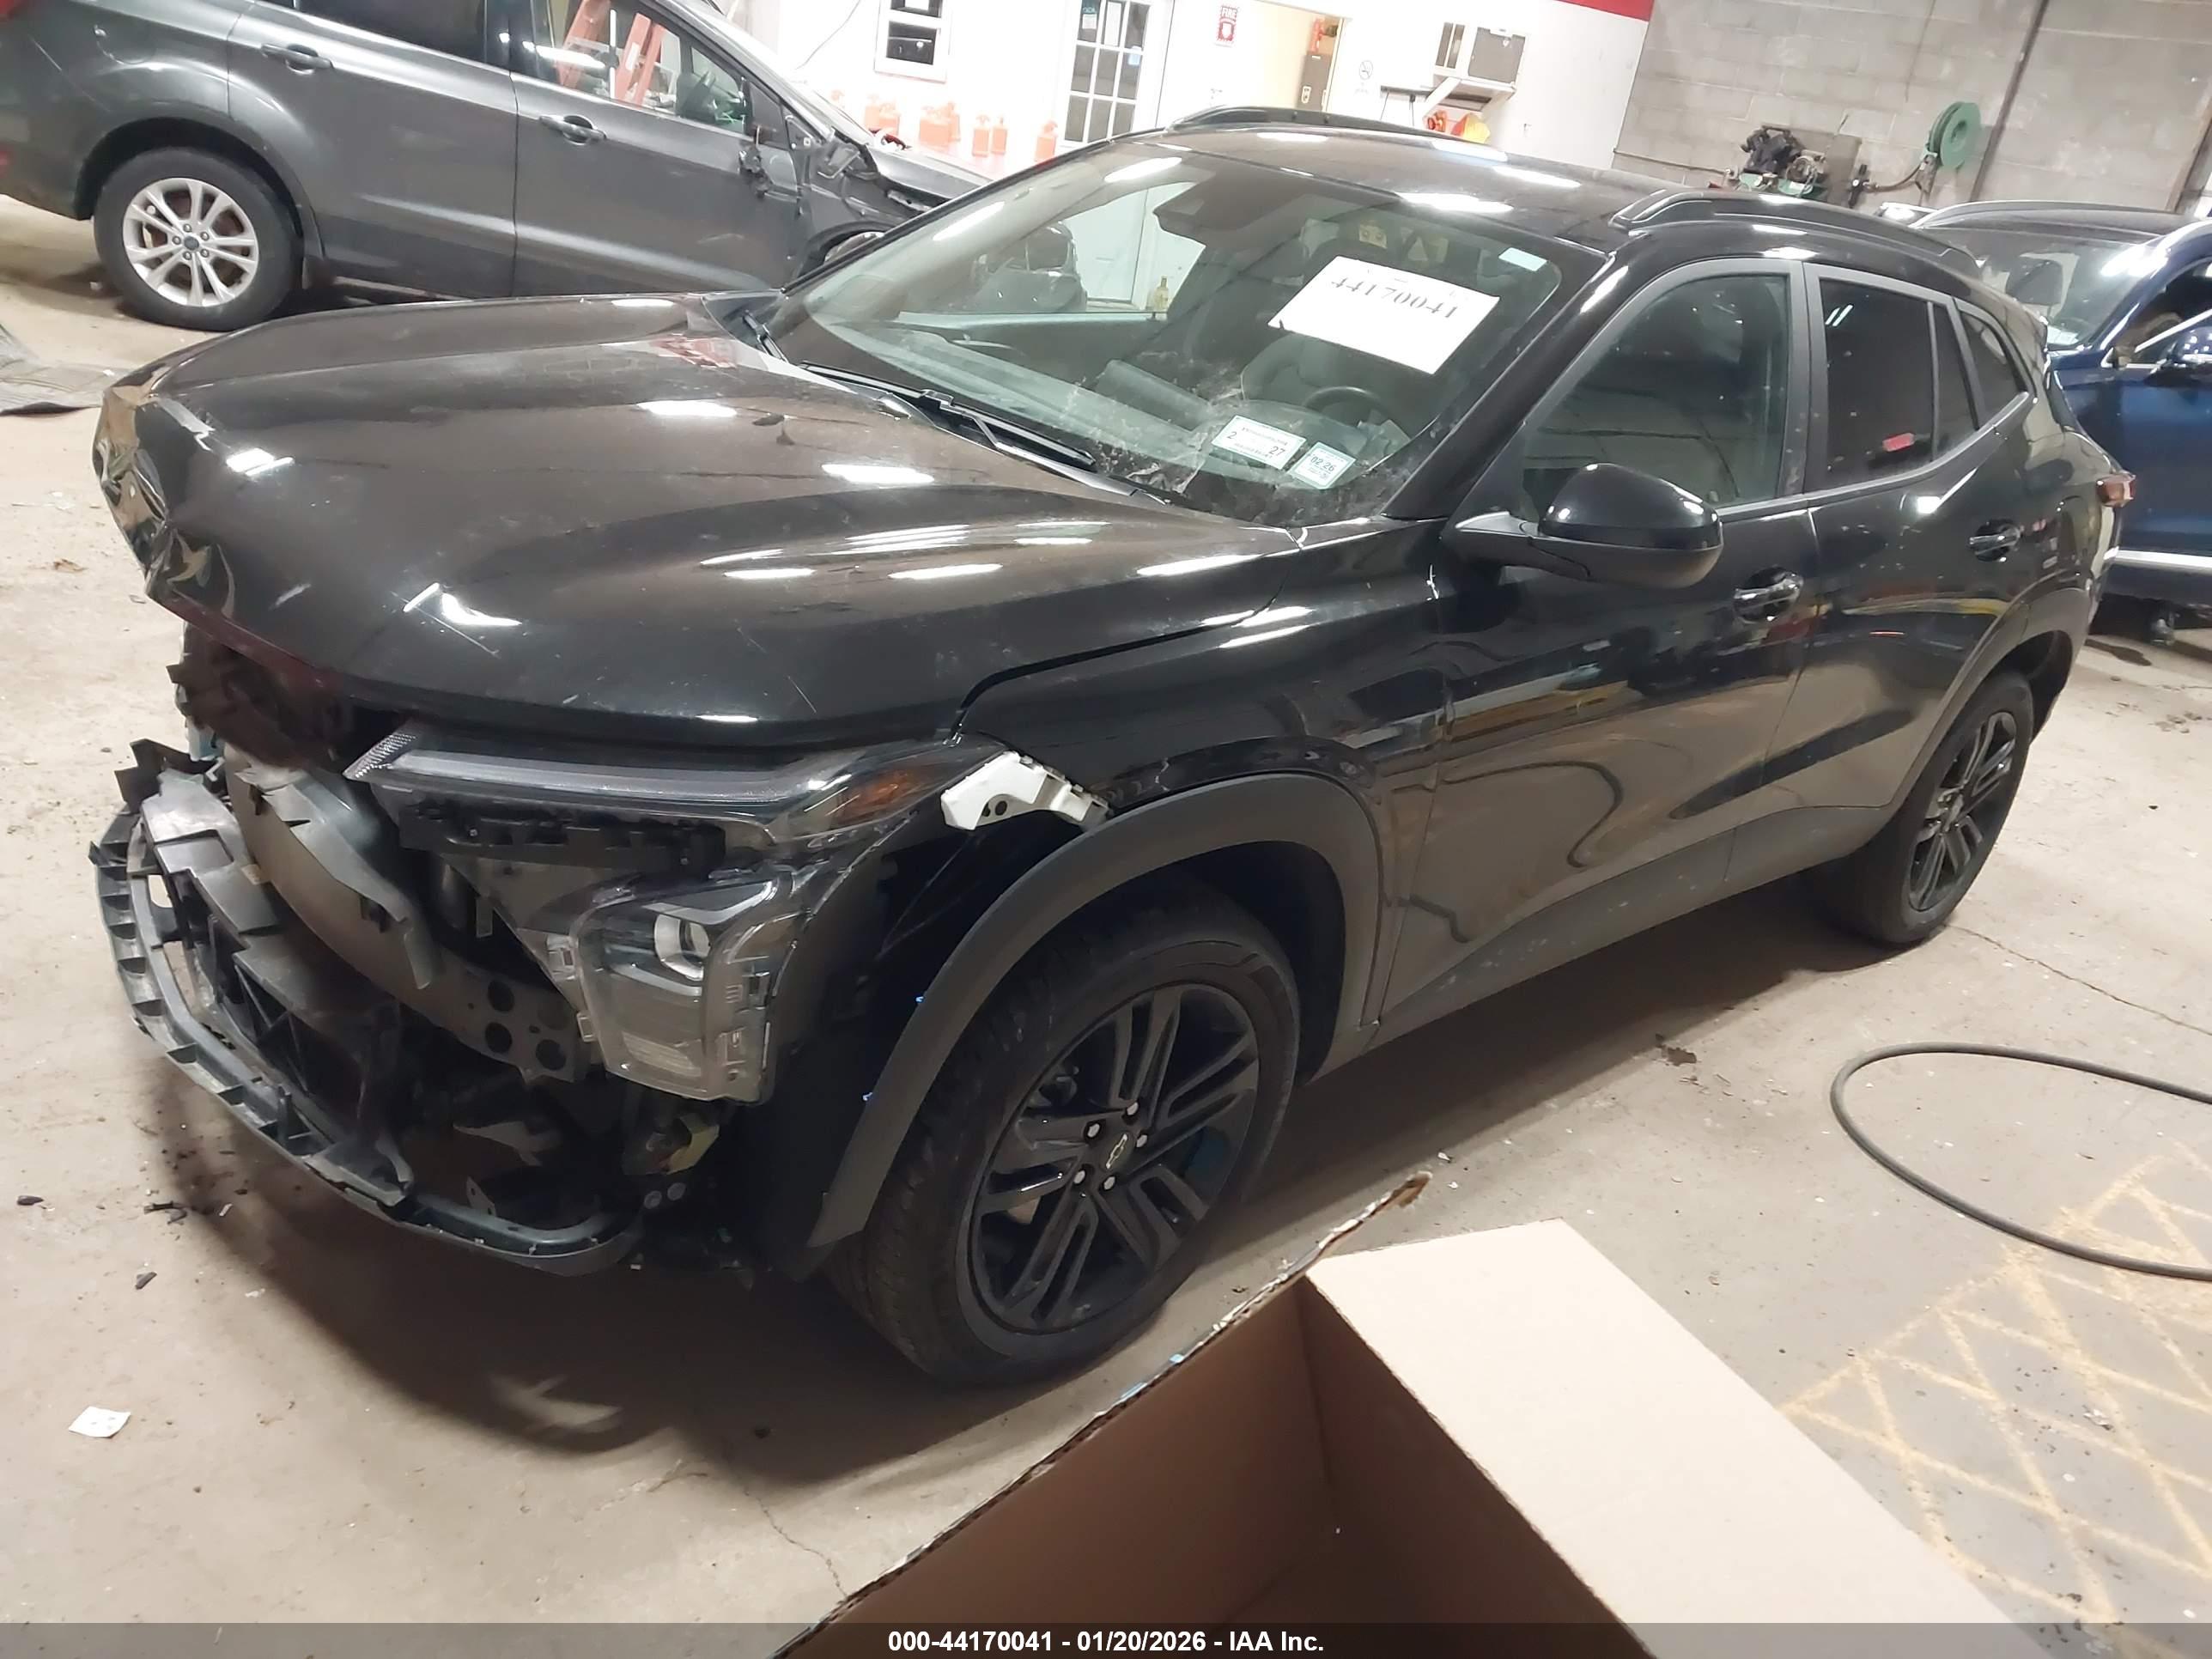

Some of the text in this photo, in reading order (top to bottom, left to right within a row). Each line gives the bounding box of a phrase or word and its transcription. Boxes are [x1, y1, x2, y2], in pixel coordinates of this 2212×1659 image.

[1221, 6, 1237, 19] FIRE
[1331, 277, 1458, 318] 44170041
[1226, 431, 1237, 440] 2
[1268, 446, 1285, 457] 27
